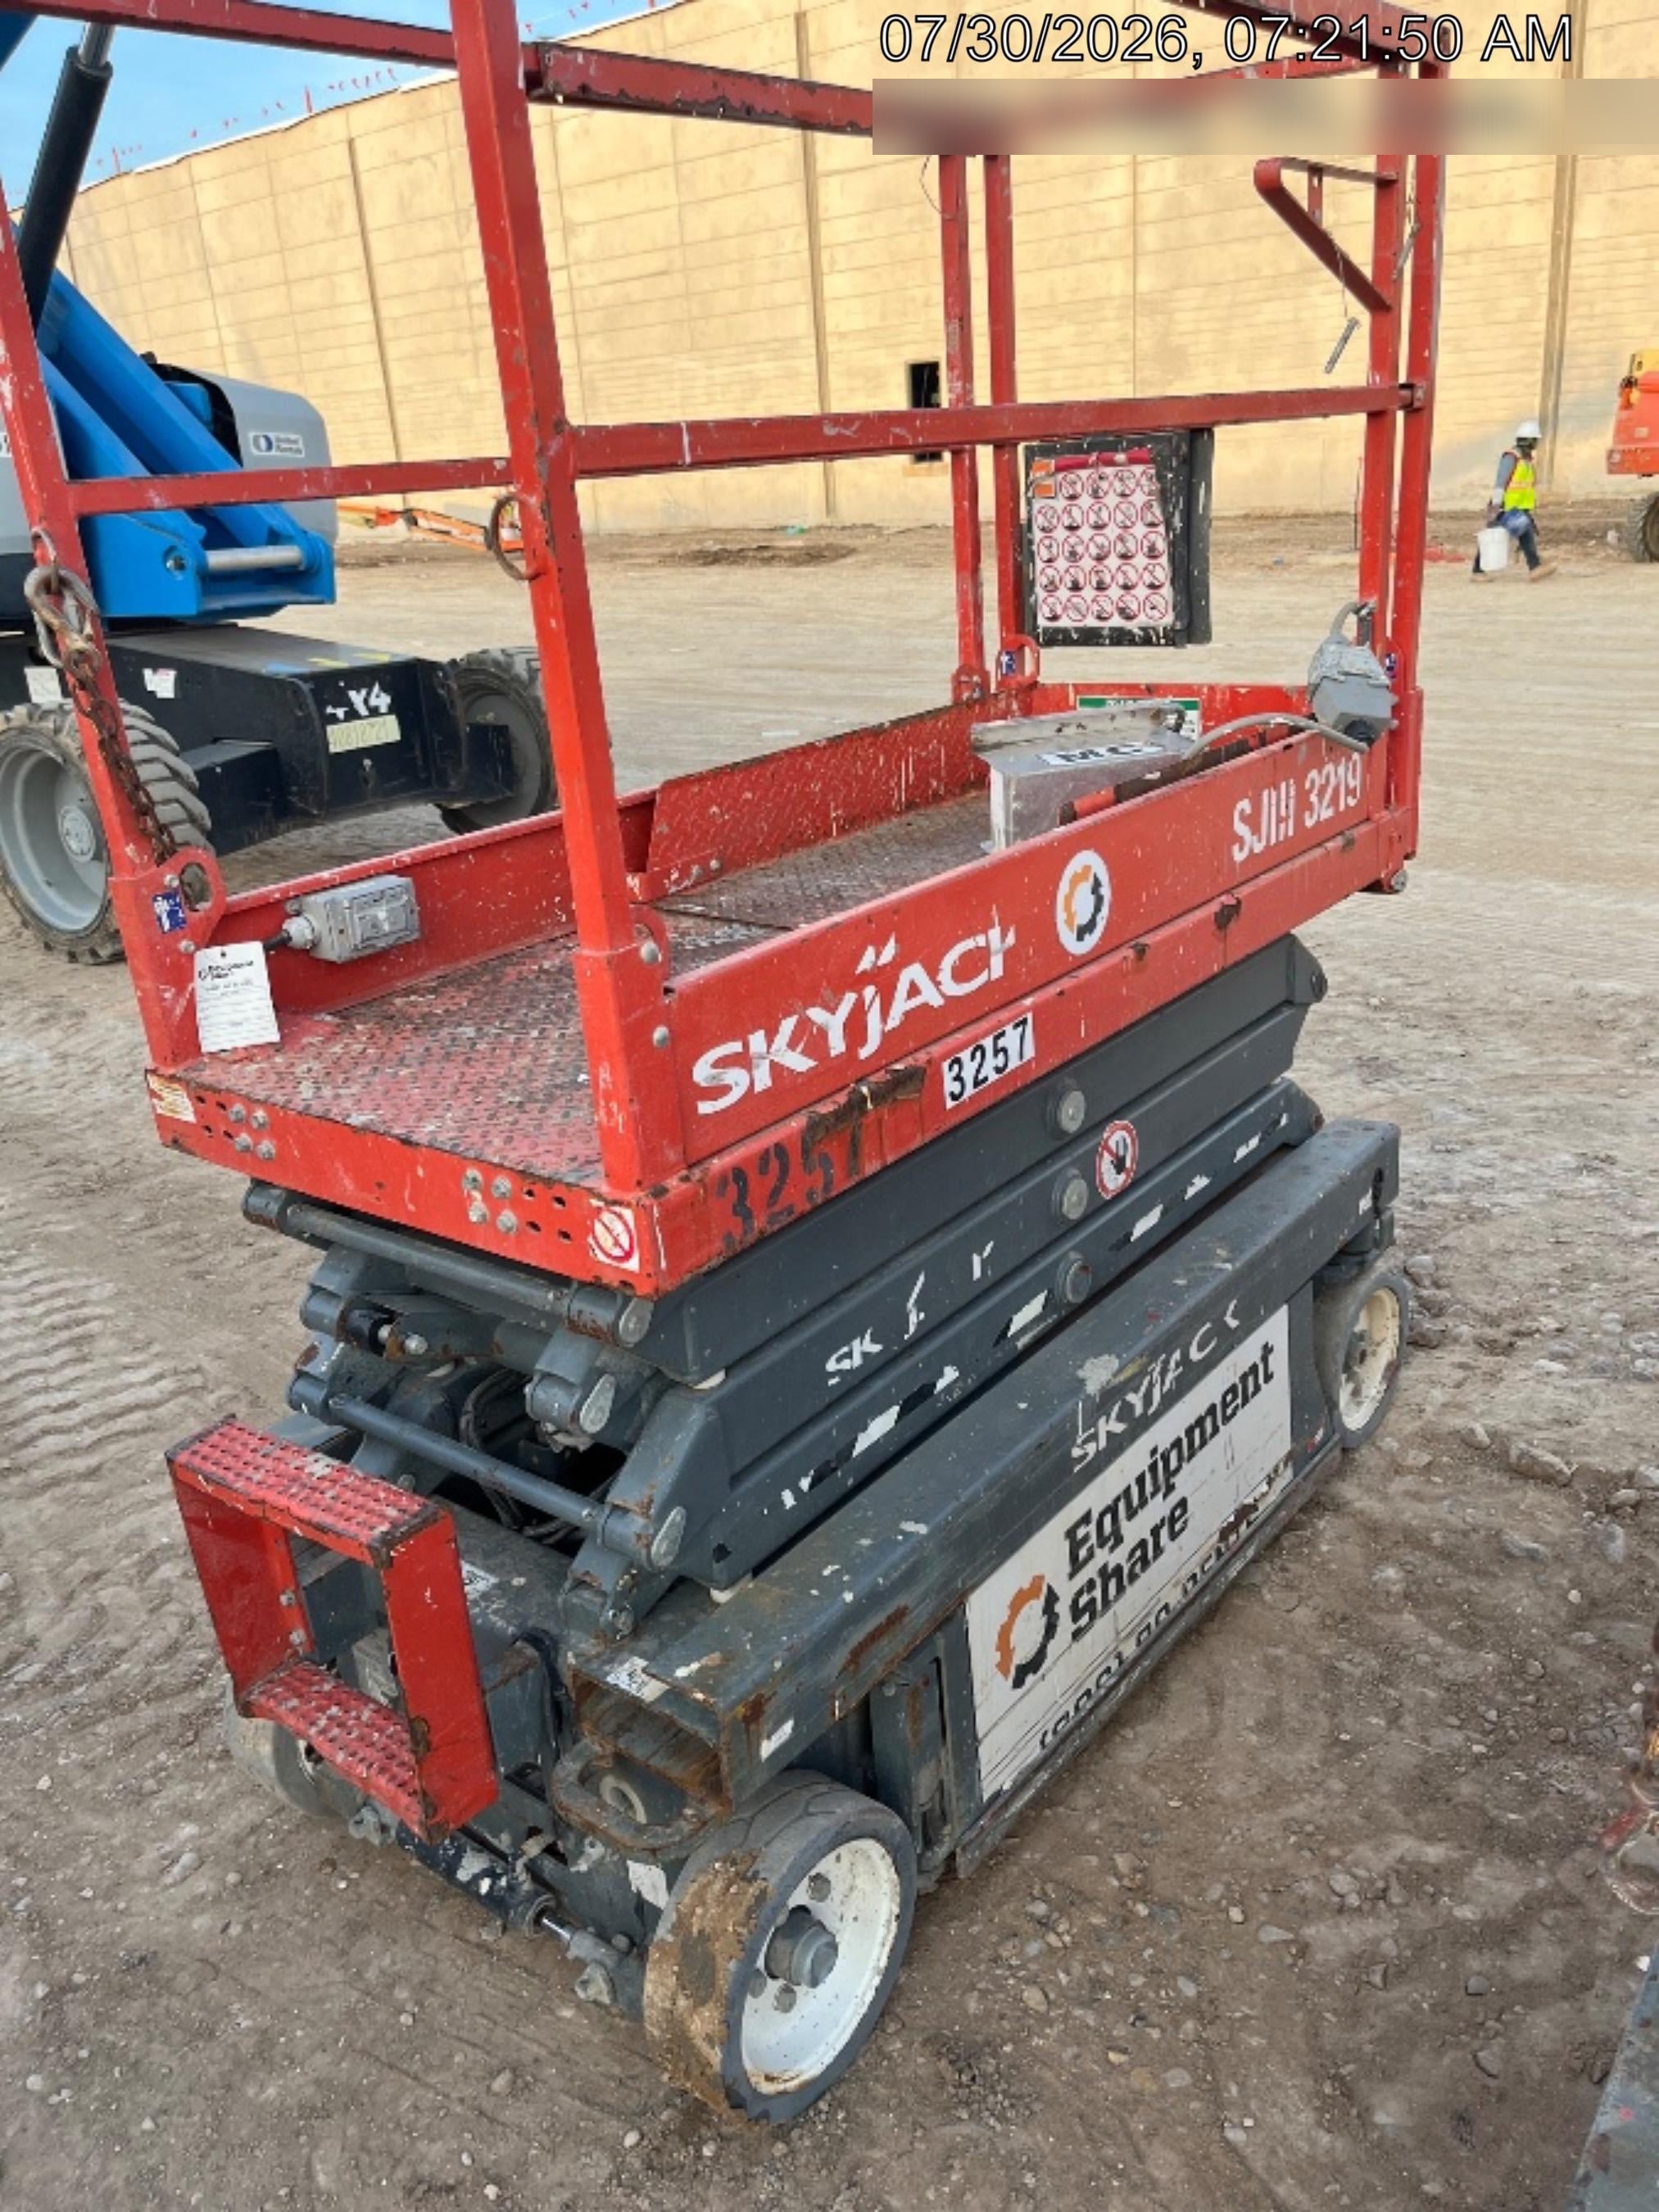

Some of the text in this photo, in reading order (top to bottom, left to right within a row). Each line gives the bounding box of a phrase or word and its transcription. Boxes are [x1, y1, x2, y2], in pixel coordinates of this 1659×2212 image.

[1304, 752, 1361, 829] 3219
[948, 1017, 1030, 1102] 3257
[1065, 1341, 1275, 1580] Equipment
[1069, 1496, 1189, 1642] Share
